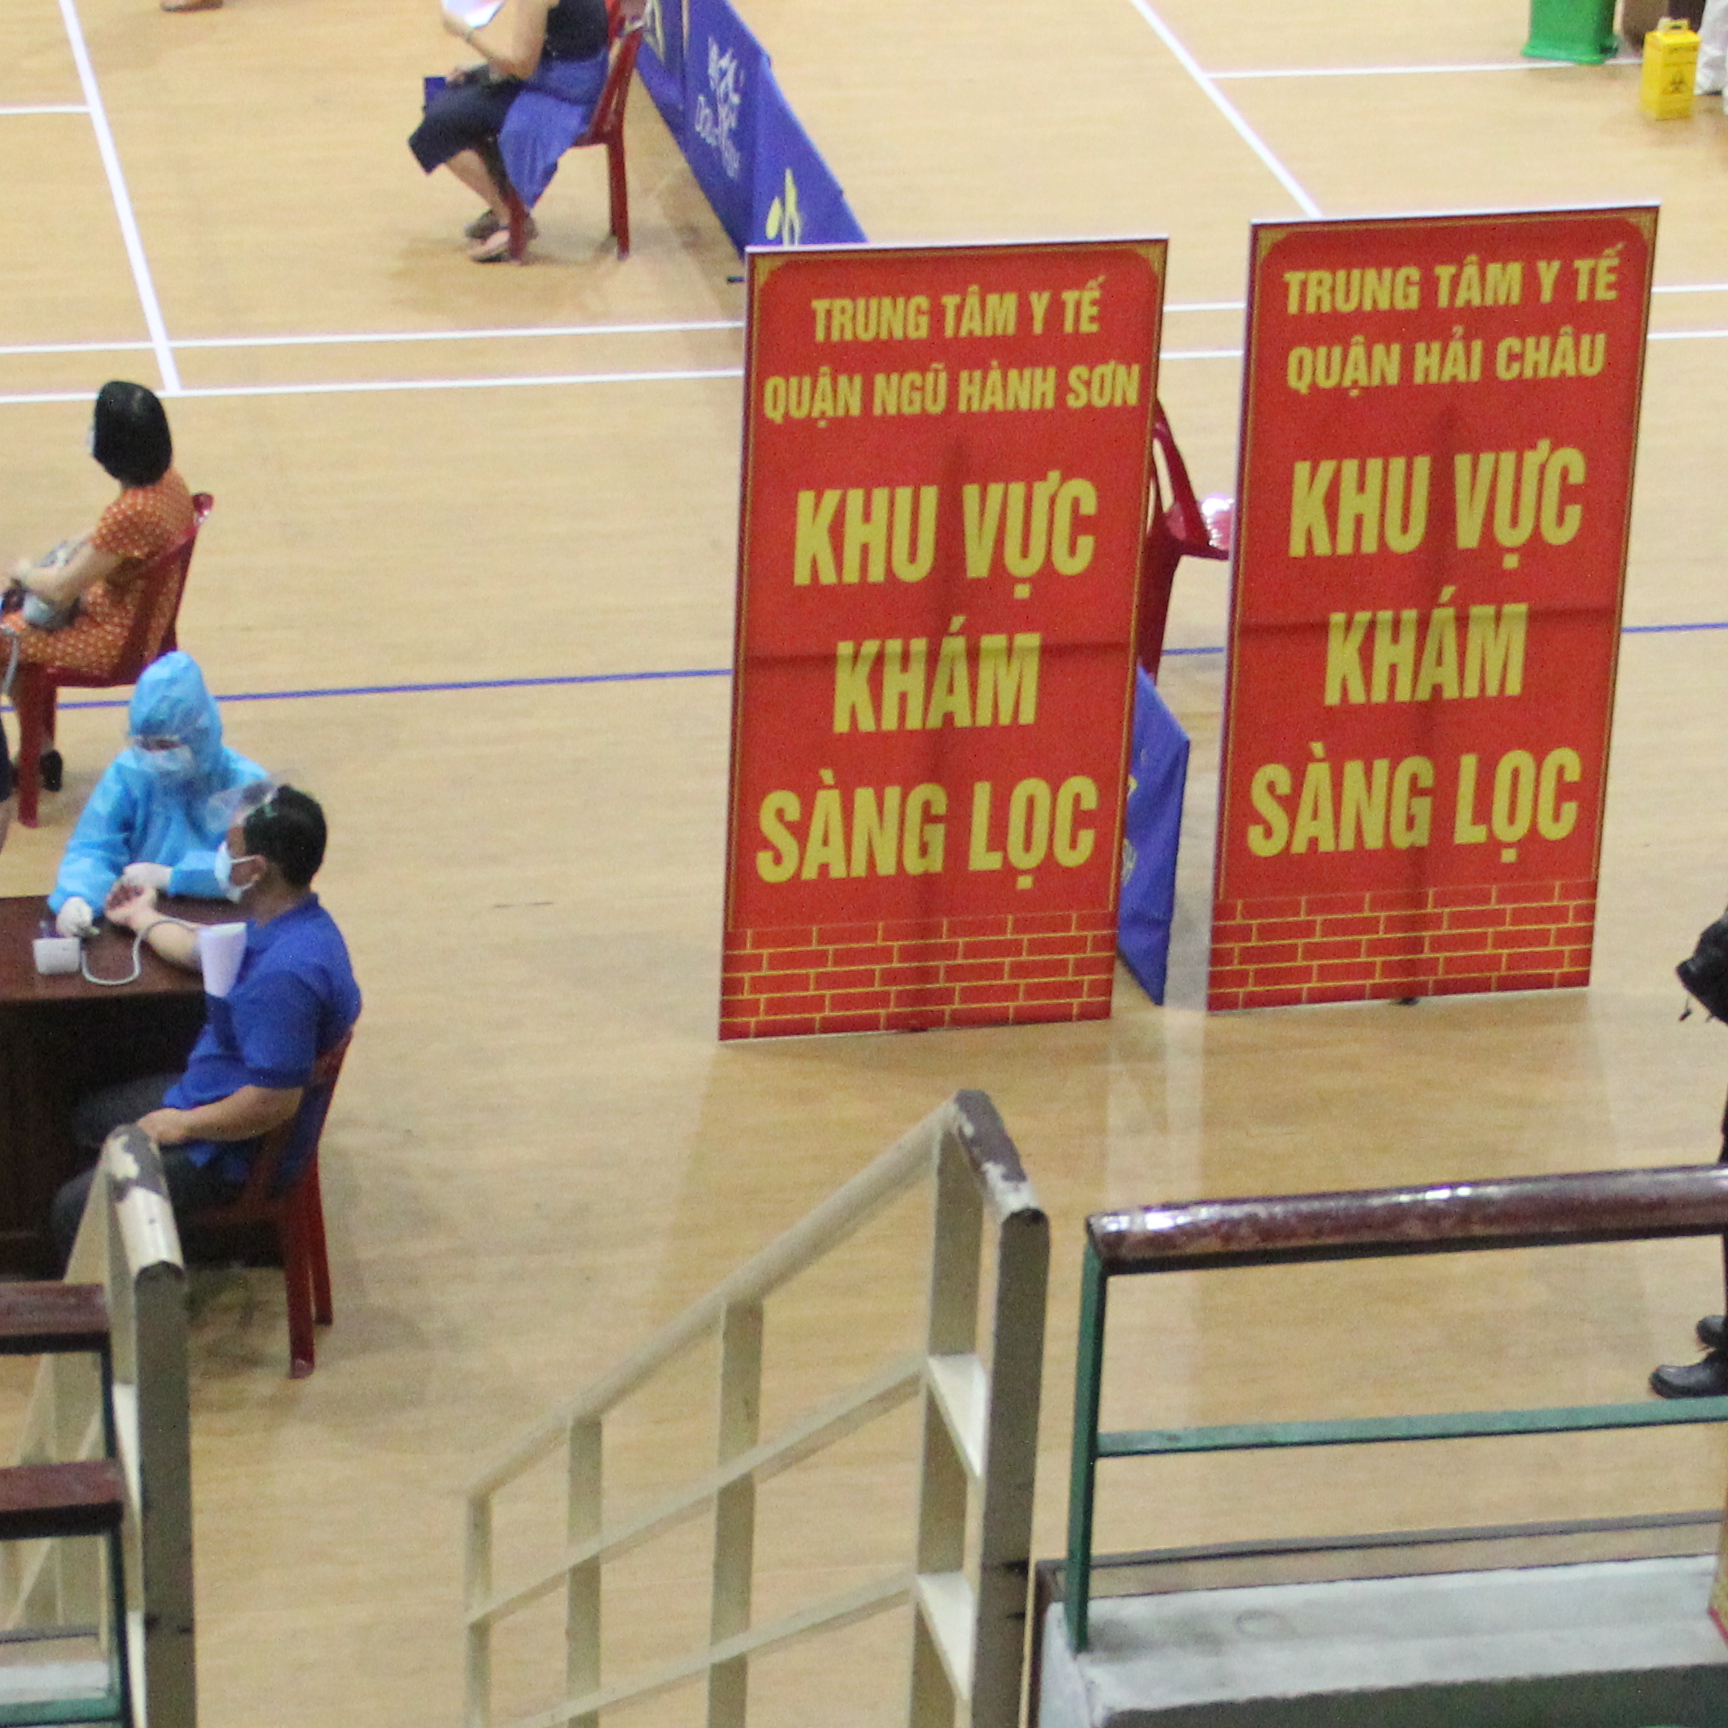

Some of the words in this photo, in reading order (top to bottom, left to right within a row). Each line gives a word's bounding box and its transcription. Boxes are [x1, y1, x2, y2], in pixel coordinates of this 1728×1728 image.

[811, 298, 930, 343] TRUNG
[942, 284, 1018, 339] TÂM
[1029, 292, 1050, 332] Y
[1060, 275, 1107, 335] TẾ
[1283, 267, 1421, 314] TRUNG
[1434, 254, 1523, 308] TÂM
[1537, 261, 1561, 304] Y
[1574, 243, 1624, 303] TẾ
[763, 367, 863, 429] QUẬN
[873, 364, 948, 418] NGŨ
[958, 361, 1057, 413] HÀNH
[1066, 359, 1140, 409] SƠN
[1287, 334, 1400, 398] QUẬN
[1413, 326, 1482, 384] HẢI
[1496, 326, 1606, 380] CHÂU
[794, 484, 939, 586] KHU
[963, 469, 1099, 599] VỰC
[1288, 458, 1432, 558] KHU
[1455, 438, 1587, 568] VỰC
[833, 614, 1042, 734] KHÁM
[1324, 585, 1529, 707] KHÁM
[756, 770, 947, 884] SÀNG
[969, 774, 1099, 890] LỌC
[1248, 741, 1434, 858] SÀNG
[1454, 745, 1583, 863] LỌC
